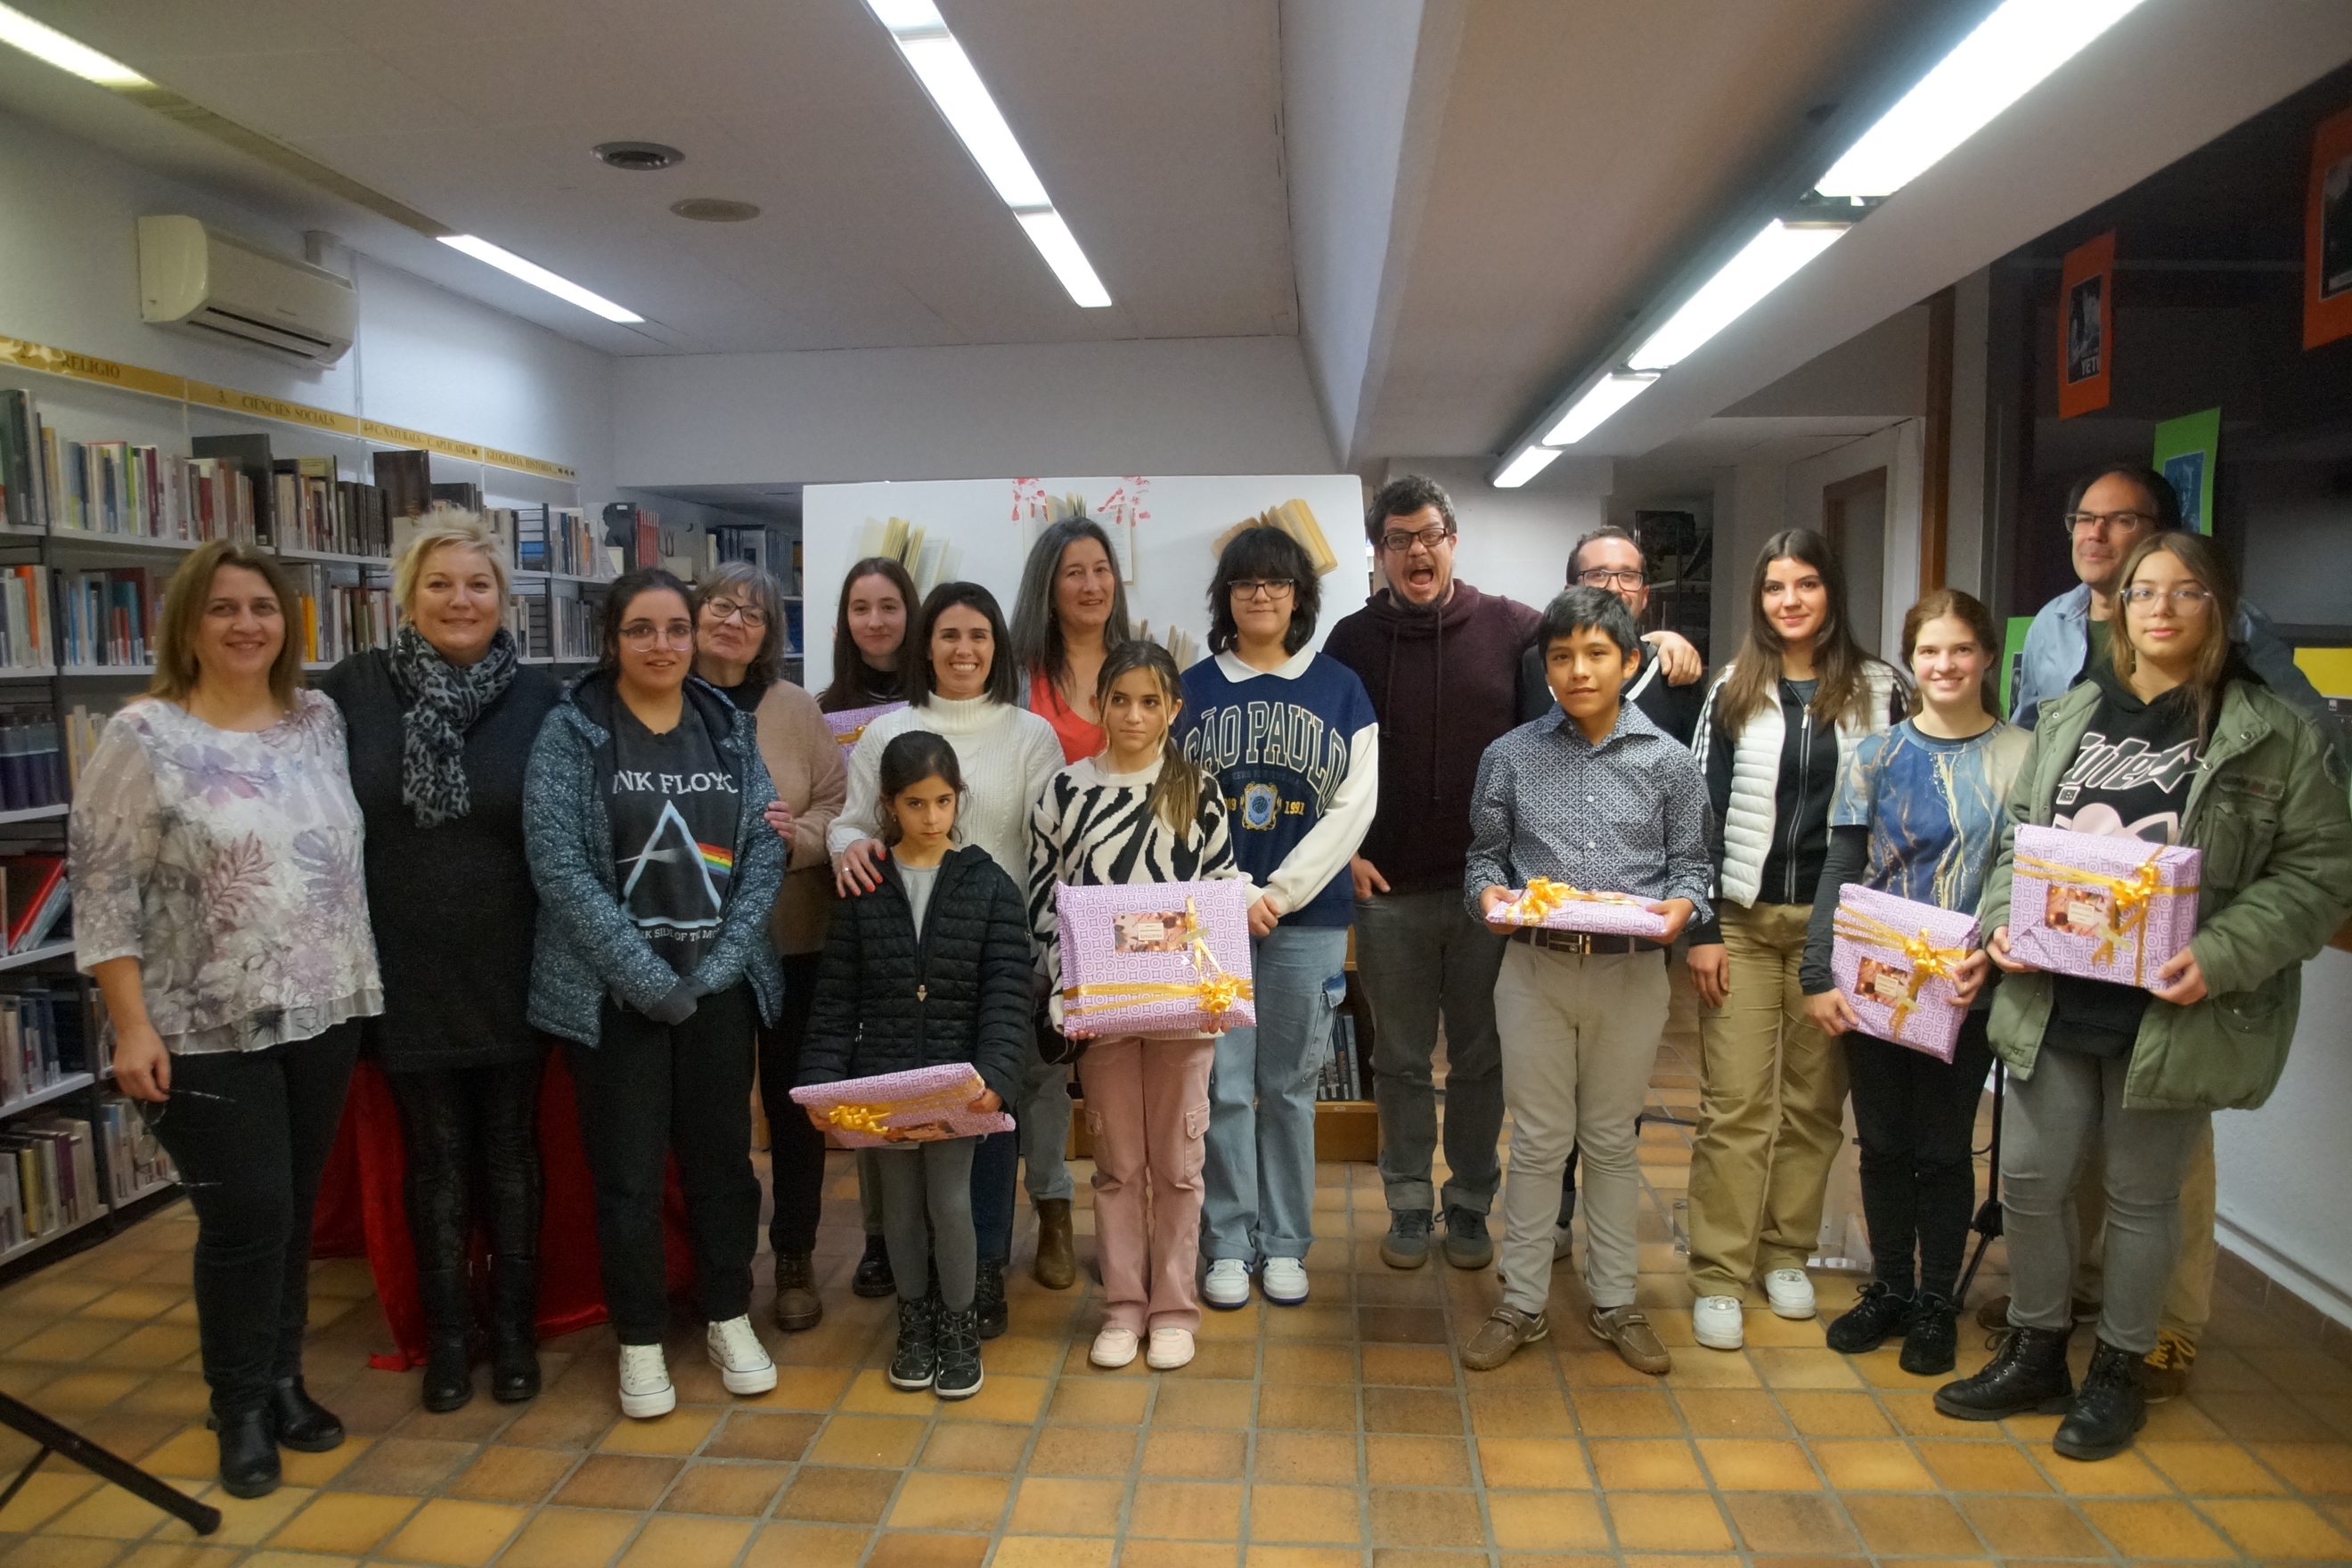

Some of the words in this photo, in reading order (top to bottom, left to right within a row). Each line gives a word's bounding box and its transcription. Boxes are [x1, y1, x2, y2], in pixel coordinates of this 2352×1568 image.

[2081, 356, 2099, 375] YETI
[296, 407, 335, 426] SOCIALS
[1245, 701, 1347, 819] PAULO
[612, 770, 655, 794] INK
[1284, 801, 1305, 816] 1991
[674, 932, 688, 942] OF
